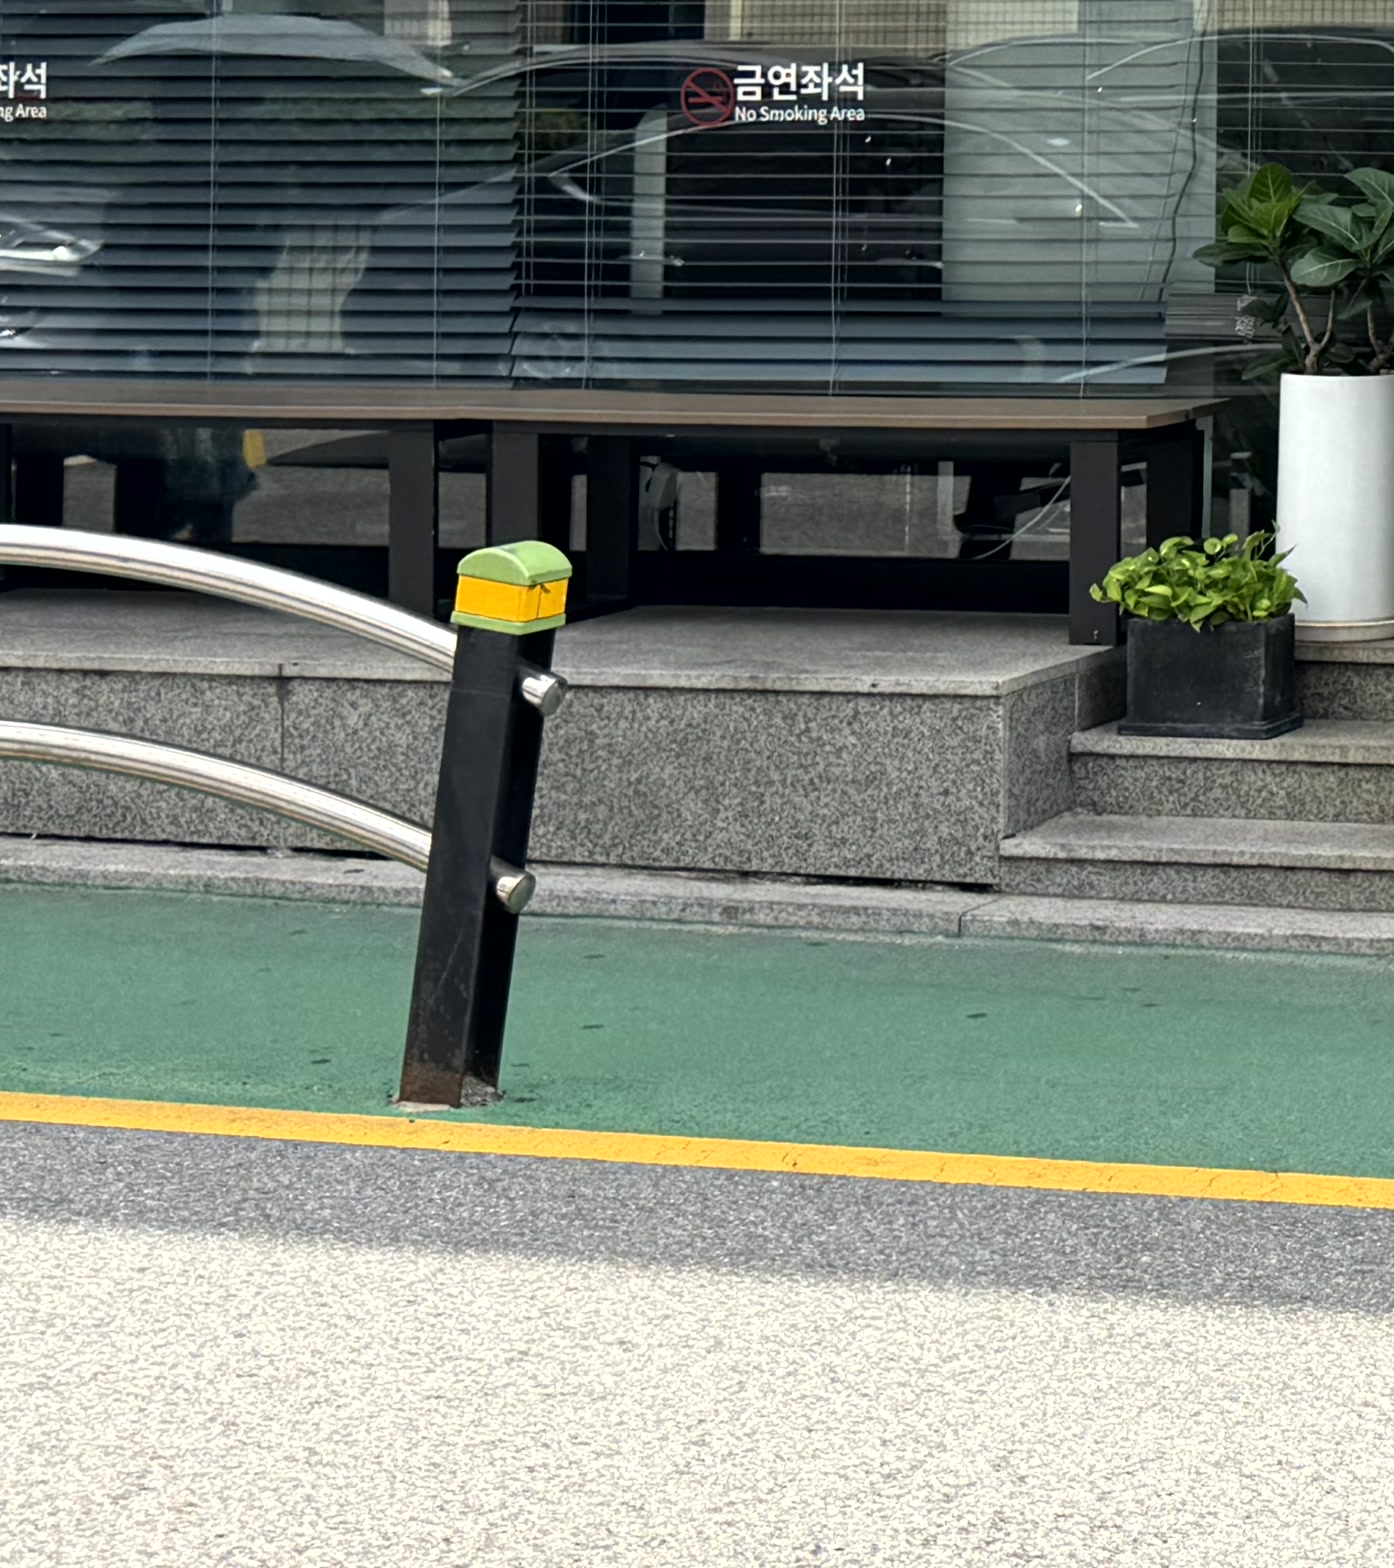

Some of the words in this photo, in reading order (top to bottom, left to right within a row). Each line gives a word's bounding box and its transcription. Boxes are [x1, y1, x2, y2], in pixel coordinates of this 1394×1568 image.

[733, 62, 865, 102] 금연좌석
[15, 103, 47, 118] Area
[734, 106, 756, 123] No
[759, 105, 827, 124] Smoking
[830, 106, 865, 120] Area
